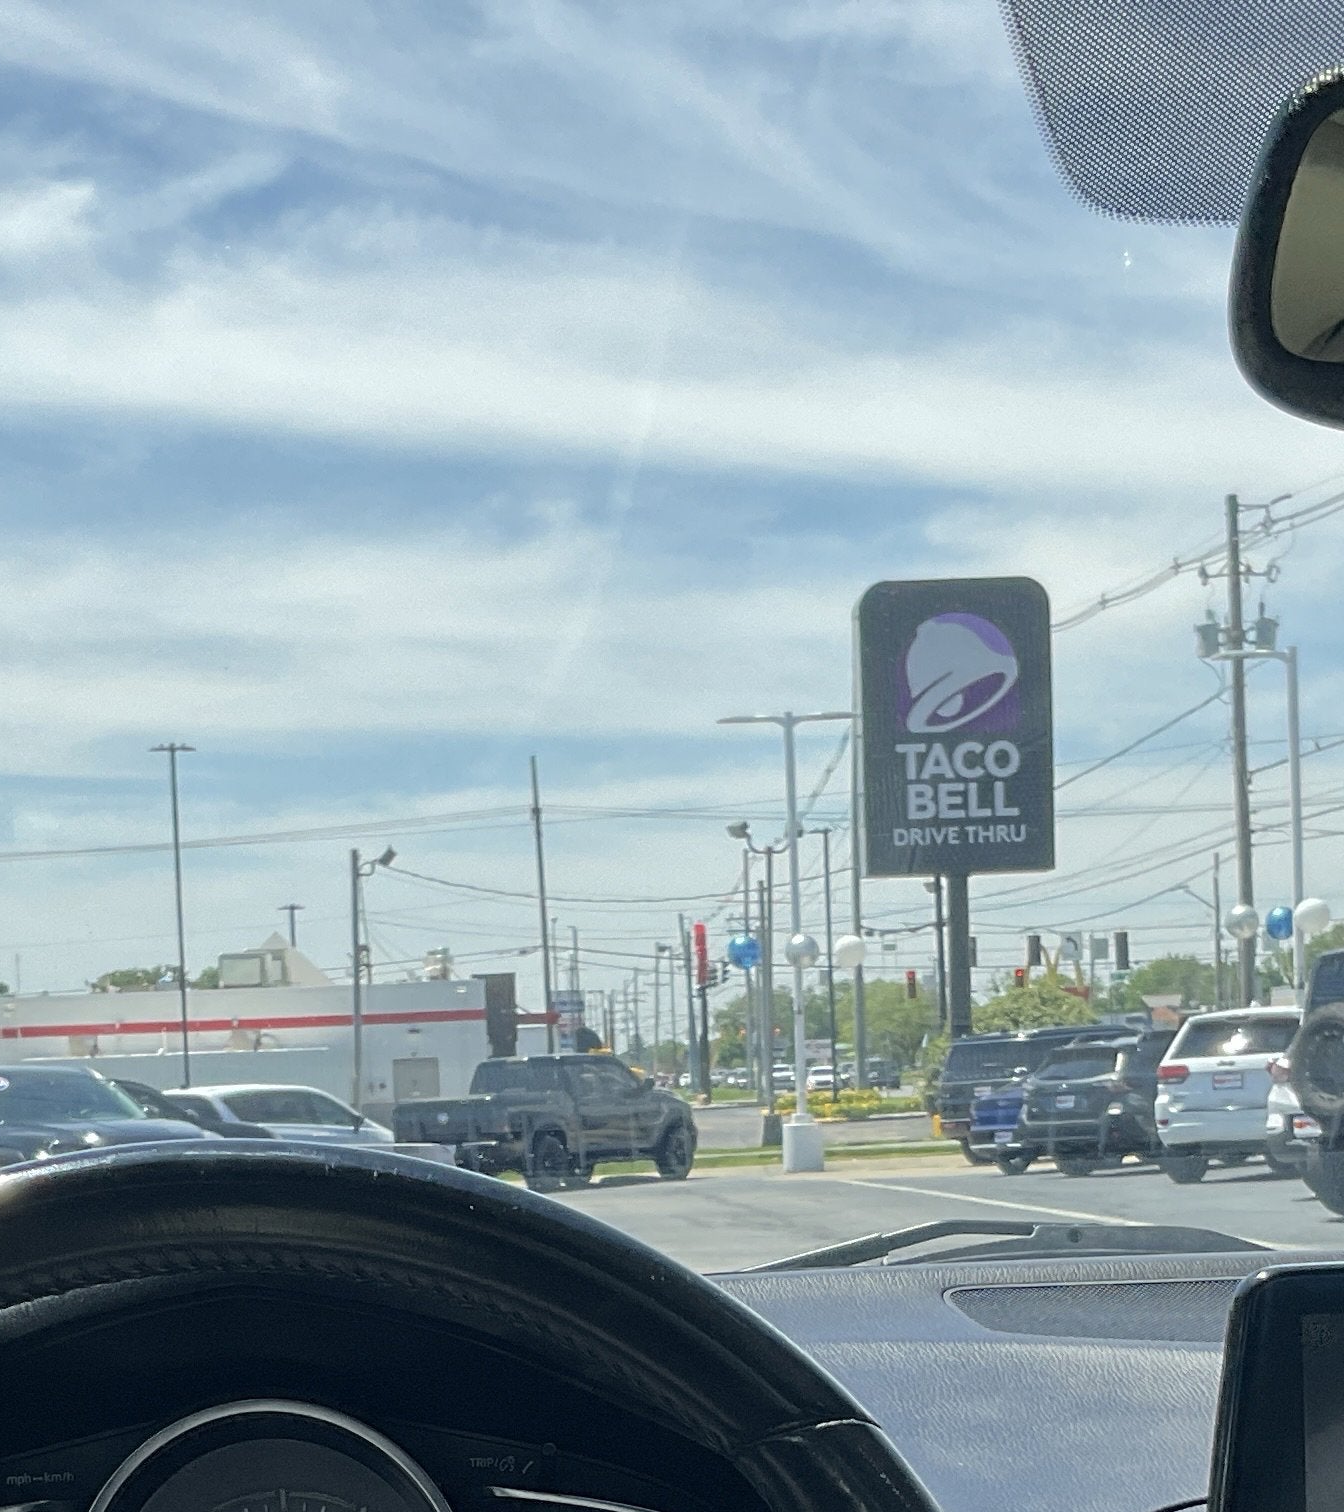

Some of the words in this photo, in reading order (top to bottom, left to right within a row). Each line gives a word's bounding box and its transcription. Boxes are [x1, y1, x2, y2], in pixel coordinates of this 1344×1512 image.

[895, 740, 1021, 781] TACO
[907, 781, 1021, 819] BELL
[893, 825, 960, 846] DRIVE
[965, 824, 1027, 844] THRU
